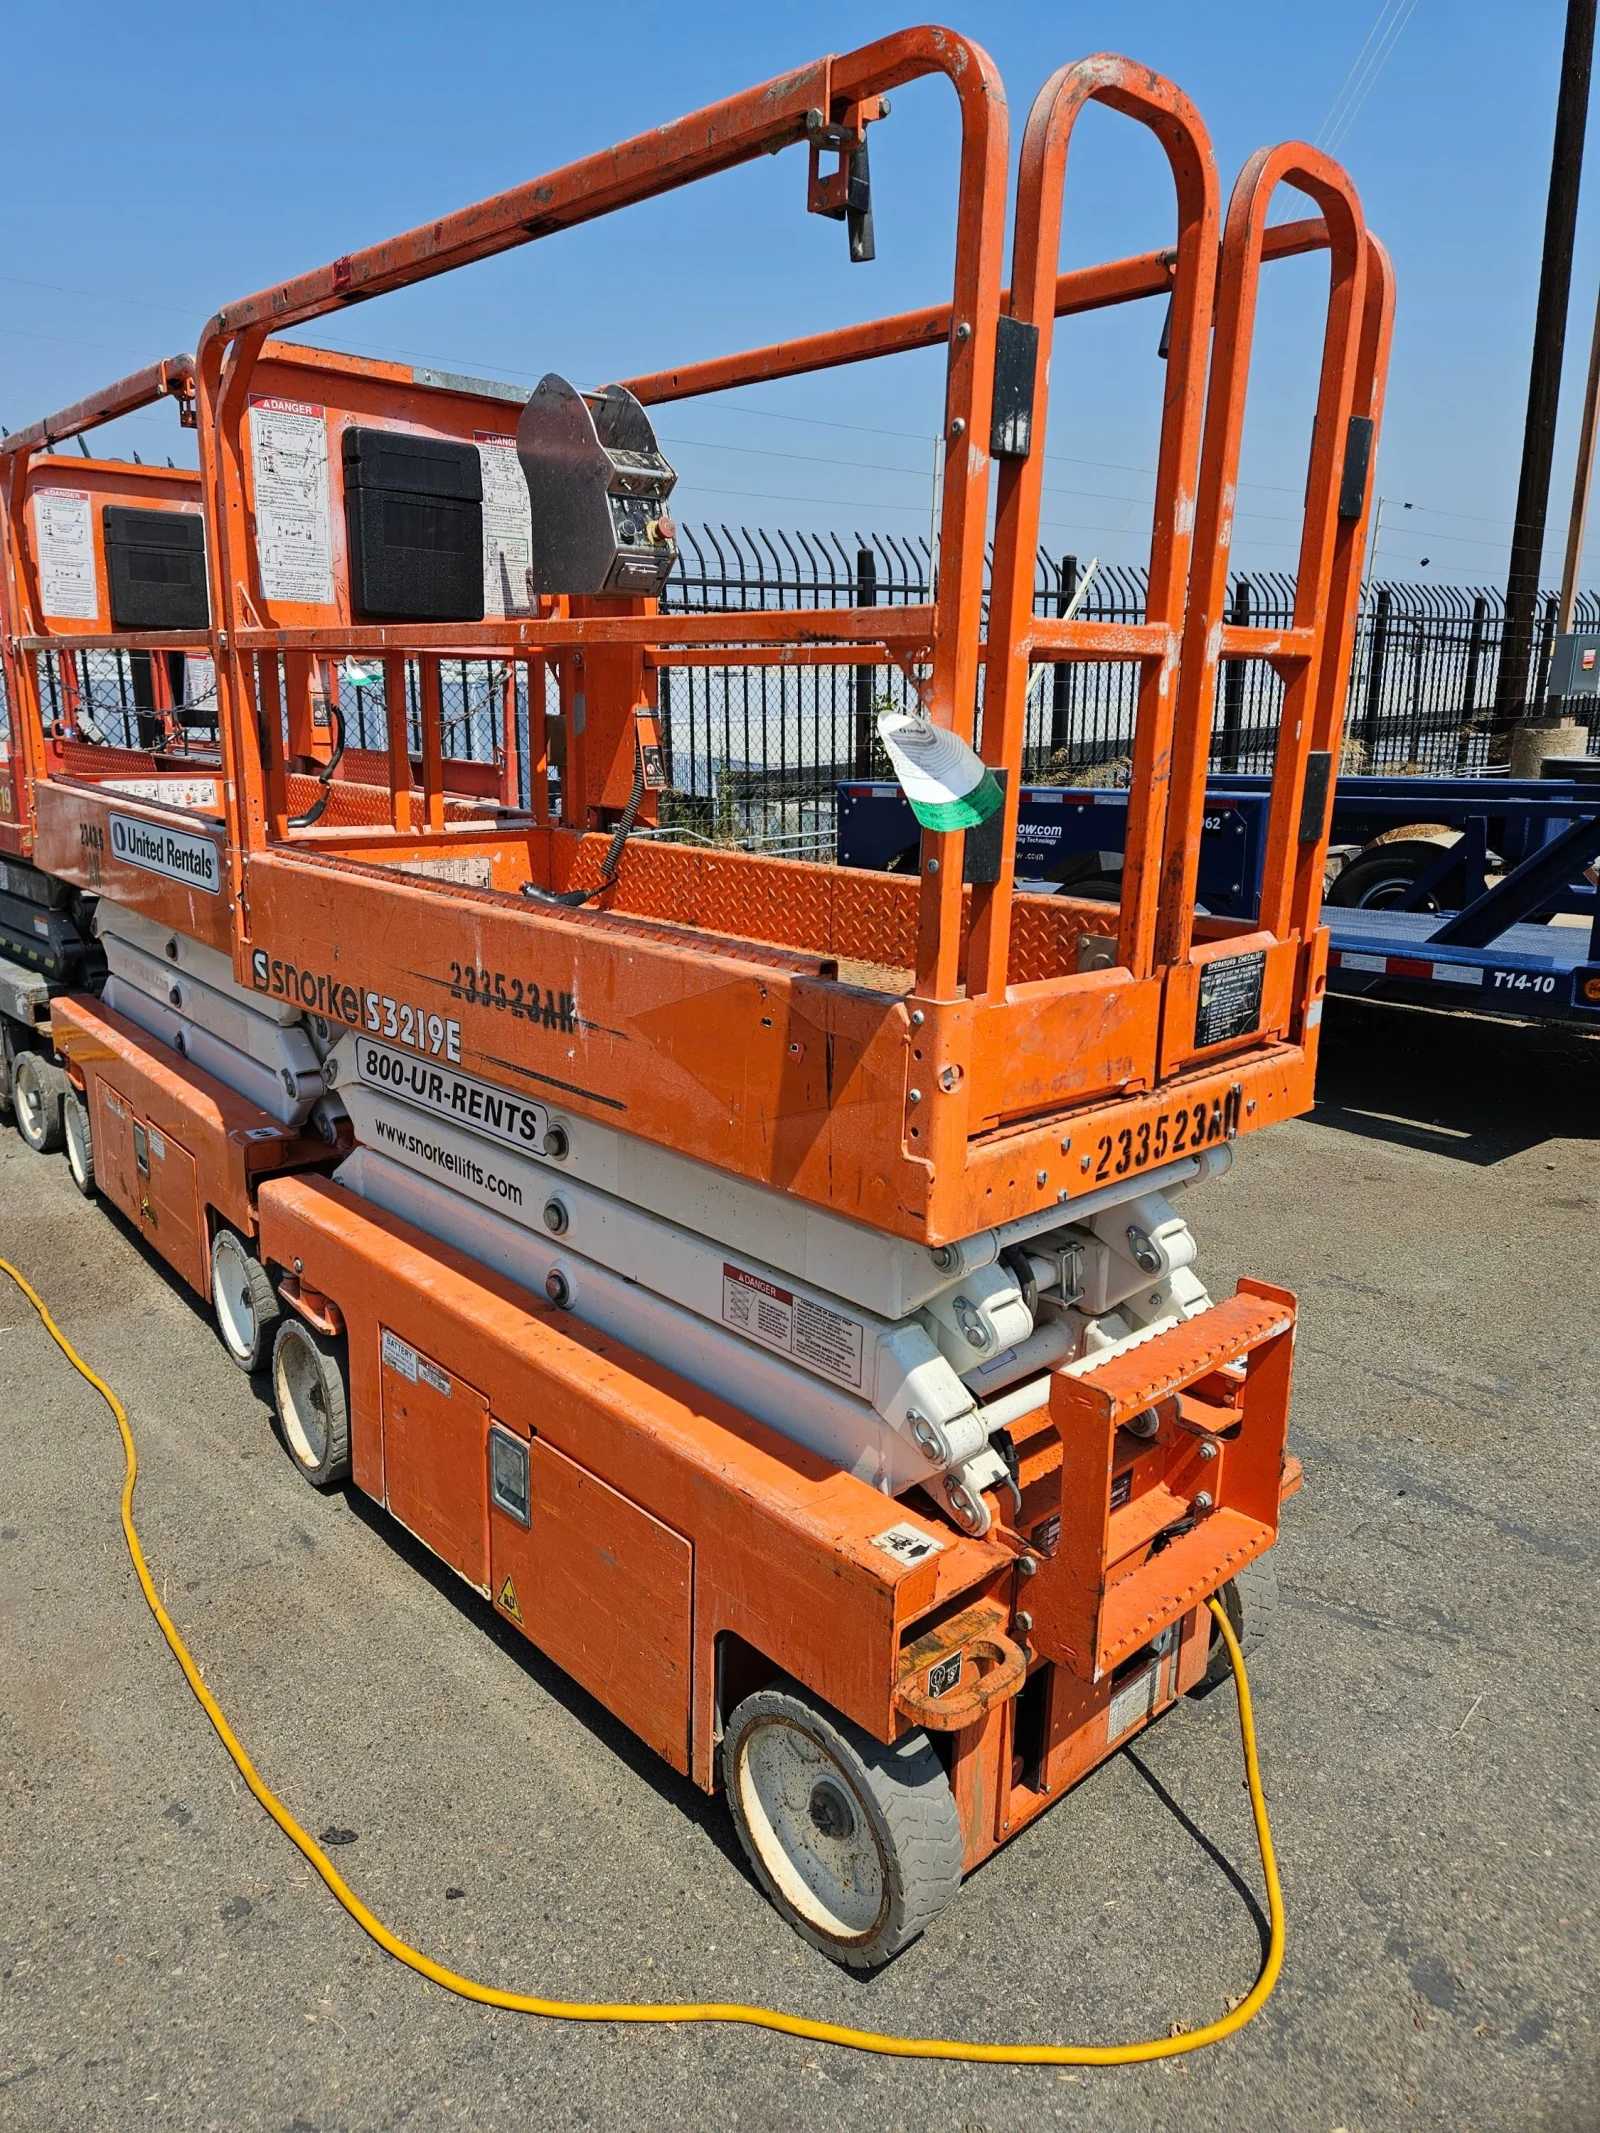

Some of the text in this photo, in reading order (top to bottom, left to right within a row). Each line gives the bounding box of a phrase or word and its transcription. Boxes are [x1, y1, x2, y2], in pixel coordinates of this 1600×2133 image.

[271, 400, 312, 415] DANGER
[49, 489, 81, 499] DANGER
[1016, 824, 1062, 836] ow.com
[1027, 837, 1057, 846] Technology
[127, 826, 213, 879] United Rentals
[1208, 952, 1263, 970] OPERATORS CHECKLIST
[1493, 971, 1556, 994] T14-10
[271, 959, 366, 1028] snorkel
[365, 992, 462, 1065] S3219E
[366, 1050, 537, 1141] 800-UR-RENTS
[375, 1119, 523, 1206] www.snorkellifts.com
[744, 1274, 777, 1297] DANGER
[386, 1336, 413, 1360] BATTERY
